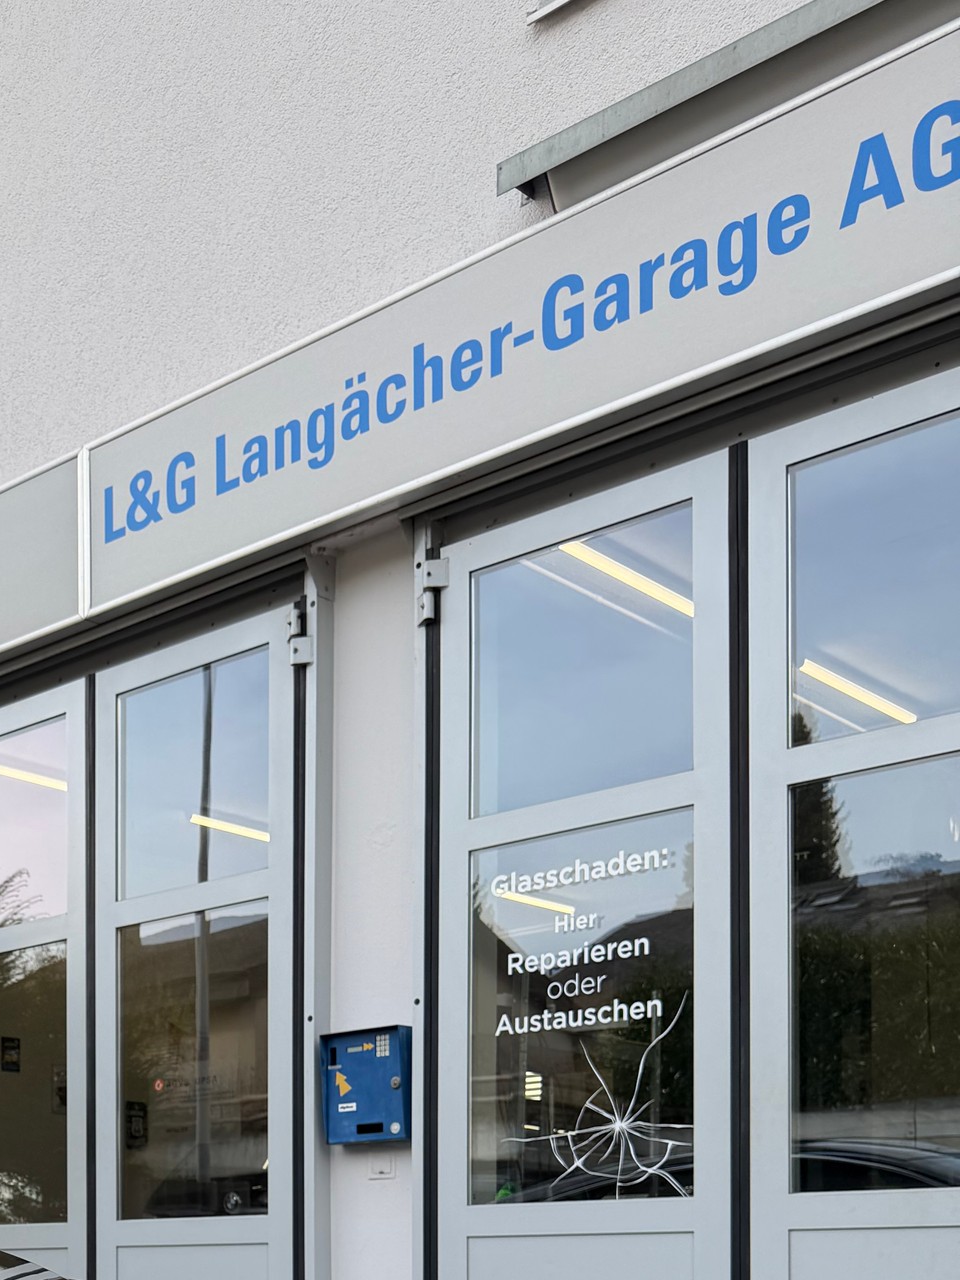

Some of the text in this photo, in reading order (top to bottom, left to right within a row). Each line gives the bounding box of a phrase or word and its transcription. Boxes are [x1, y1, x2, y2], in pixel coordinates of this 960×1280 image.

[104, 99, 960, 544] L&G Langächer-Garage AG
[490, 846, 670, 898] Glasschaden:
[553, 910, 598, 935] Hier
[507, 936, 650, 976] Reparieren
[546, 972, 607, 1001] oder
[494, 997, 663, 1037] Austauschen
